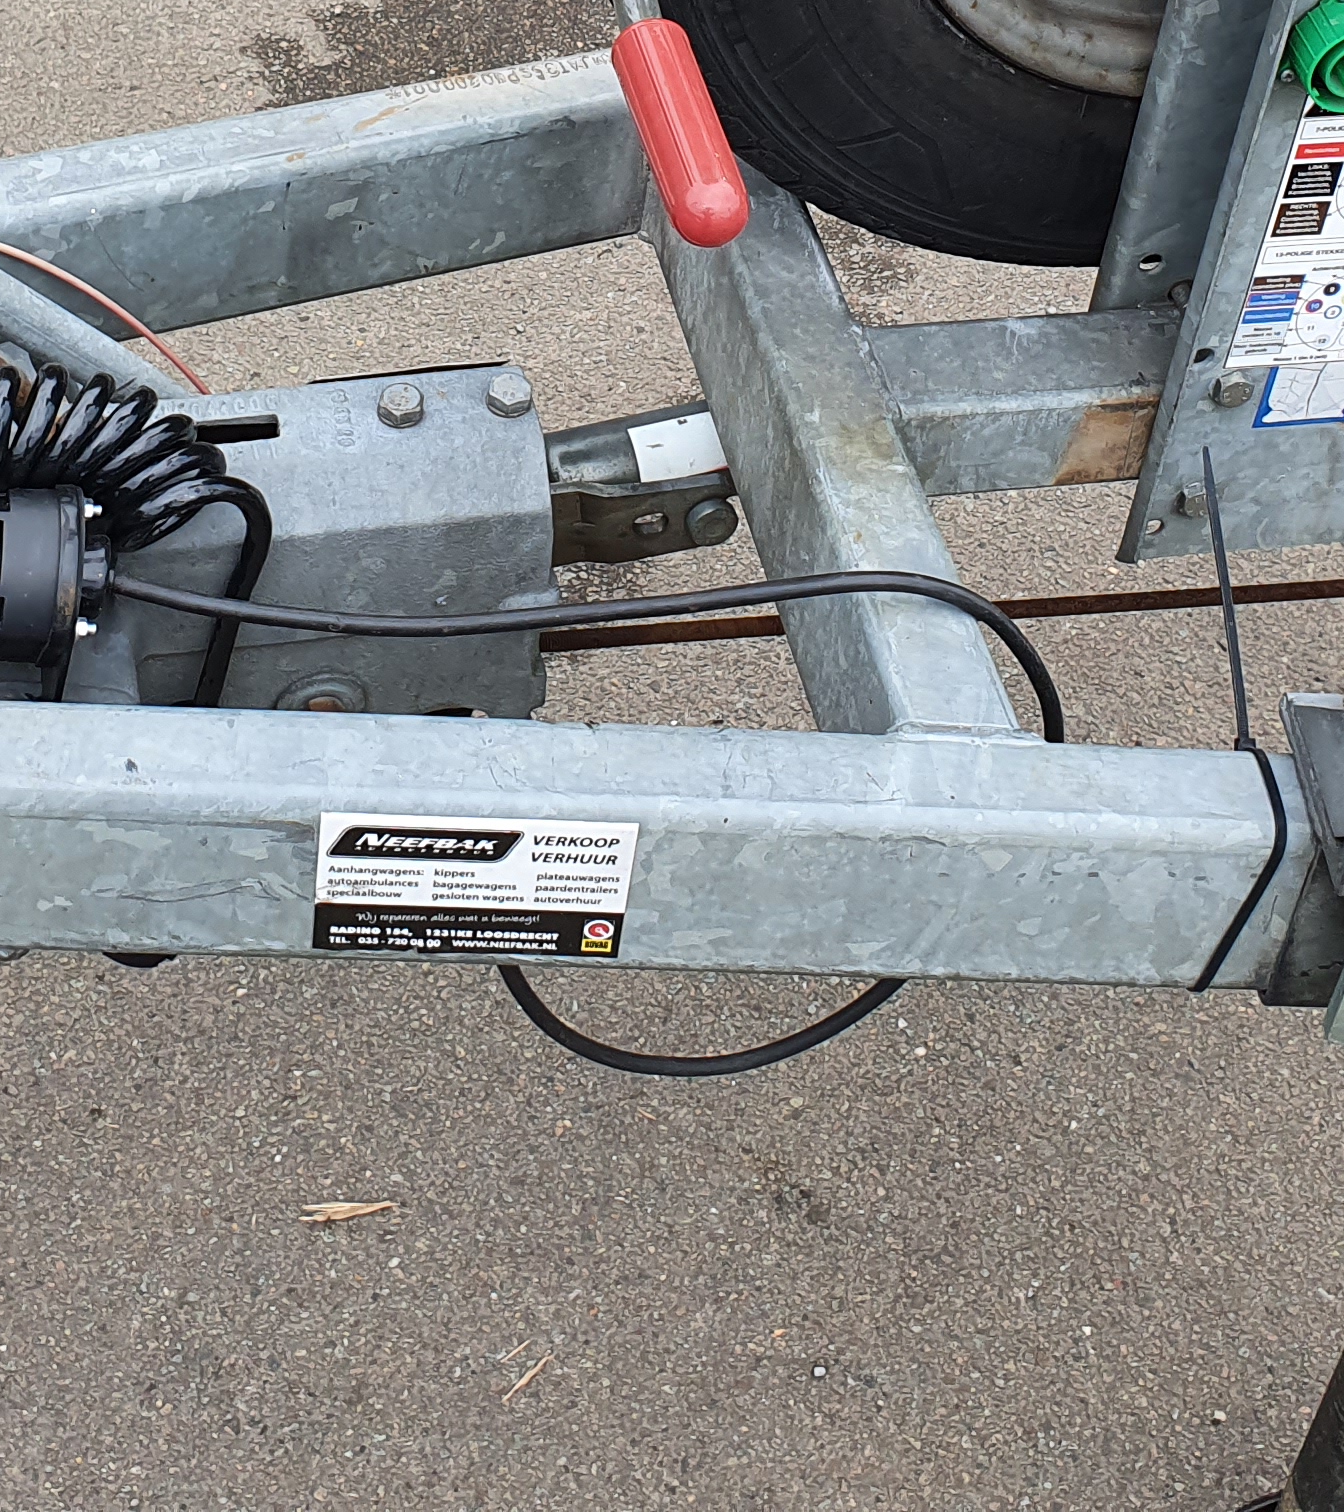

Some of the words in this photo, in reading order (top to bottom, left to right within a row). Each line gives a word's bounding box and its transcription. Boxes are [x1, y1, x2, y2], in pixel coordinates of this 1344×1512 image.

[355, 833, 499, 850] NEEFBAK
[534, 835, 621, 848] VERKOOP
[531, 852, 618, 865] VERHUUR
[328, 865, 425, 876] Aanhangwagens:
[434, 869, 475, 878] kippers
[327, 877, 419, 887] autoambulances
[536, 872, 620, 883] plateauwagens
[433, 880, 517, 891] bagagewagens
[534, 883, 619, 894] paardentrailers
[326, 889, 402, 898] speciaalbouw
[431, 892, 479, 901] gesloten
[482, 893, 524, 903] wagens
[533, 895, 602, 905] autoverhuur
[355, 911, 377, 924] Wij
[379, 913, 427, 923] repareren
[430, 912, 456, 922] alles
[329, 926, 381, 935] RADING
[426, 928, 473, 938] 1231KE
[476, 930, 560, 940] LOOSDRECHT
[329, 936, 351, 944] TEL.
[358, 936, 379, 944] 035
[387, 937, 408, 946] 720
[410, 938, 424, 947] 08
[426, 938, 441, 947] 00
[452, 939, 558, 950] WWW.NEEFBAK.NL
